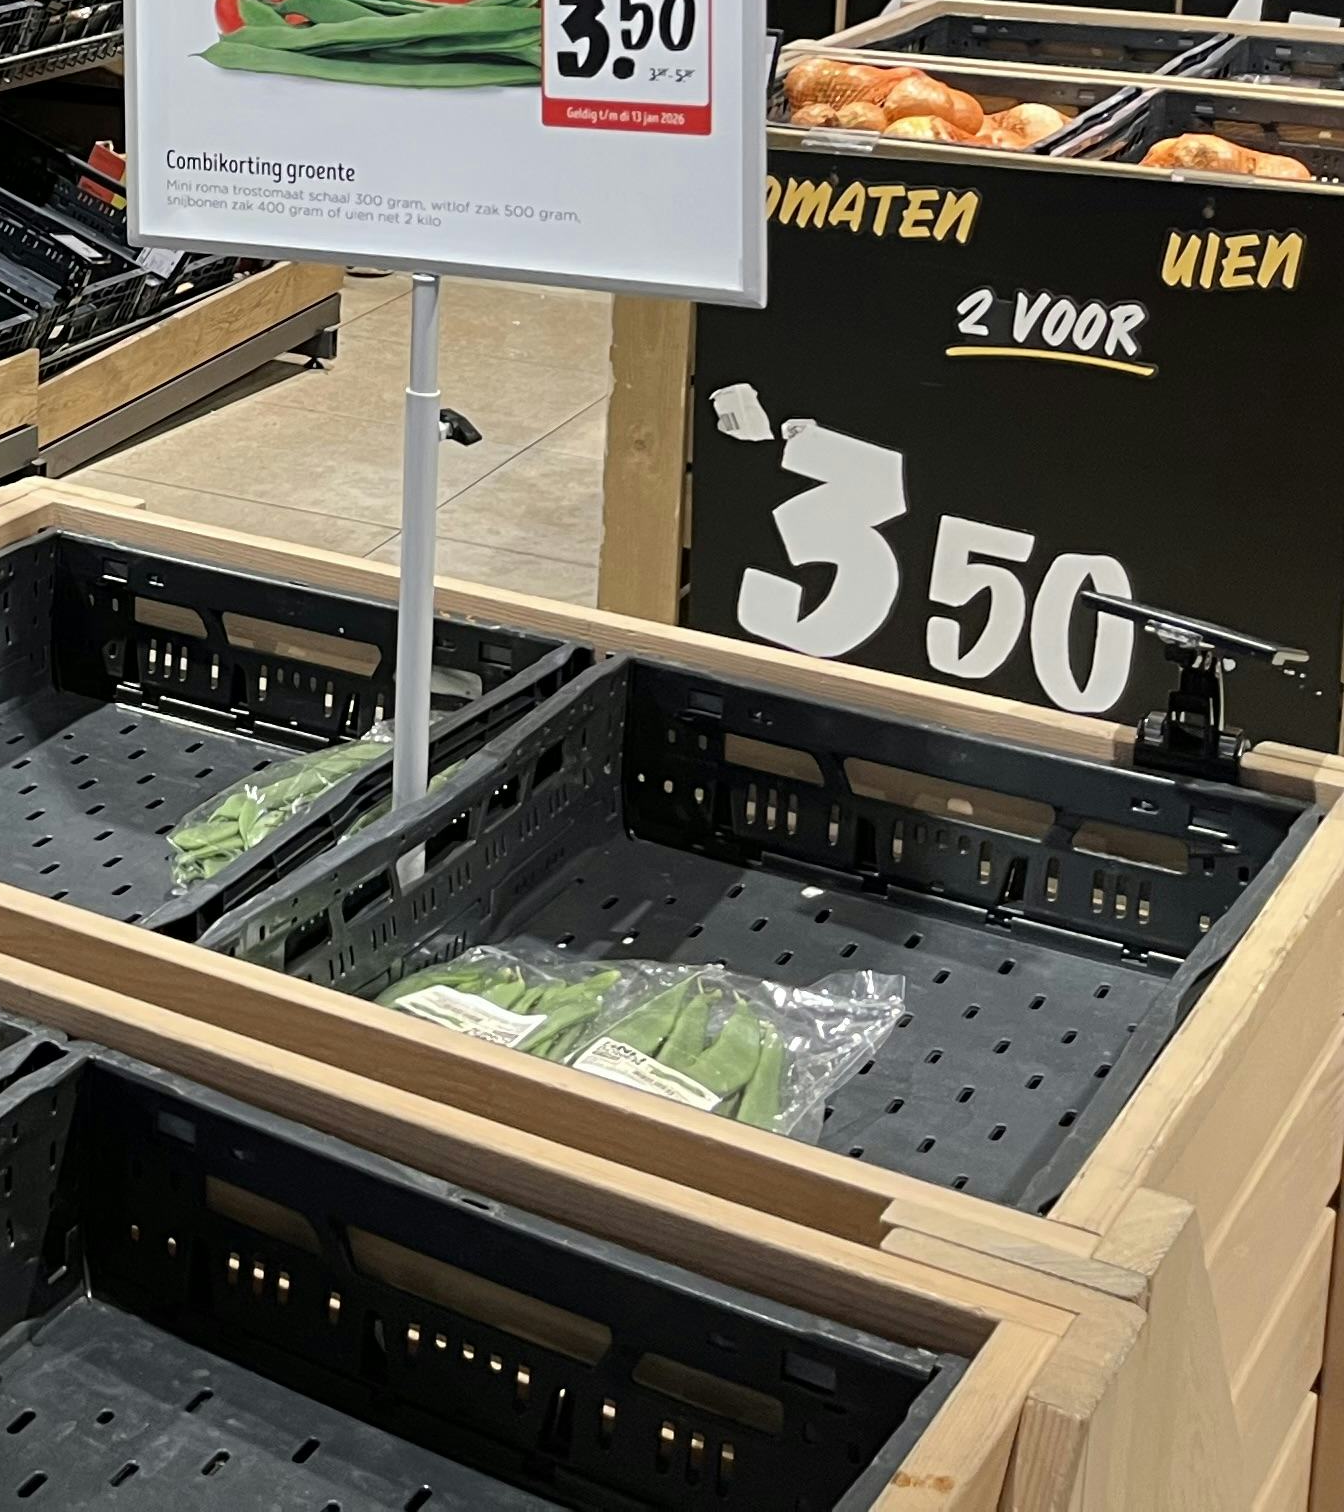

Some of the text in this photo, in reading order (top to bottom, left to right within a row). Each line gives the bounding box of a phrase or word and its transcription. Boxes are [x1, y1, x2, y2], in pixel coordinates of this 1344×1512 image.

[567, 107, 685, 125] Geldig t/m di 13 jan 2026
[166, 149, 356, 184] Combikorting groente
[167, 179, 192, 190] Mini
[195, 183, 228, 195] roma
[233, 185, 304, 201] trostomaat
[309, 191, 350, 204] schaal
[355, 193, 383, 206] 300
[431, 201, 471, 213] witlof
[475, 204, 500, 216] zak
[504, 204, 535, 218] 500
[167, 195, 442, 227] snijbonen zak 400 gram of uien net 2 kilo
[767, 175, 979, 244] OMATEN
[1161, 232, 1305, 289] UIEN
[956, 289, 1146, 357] 2 VOOR
